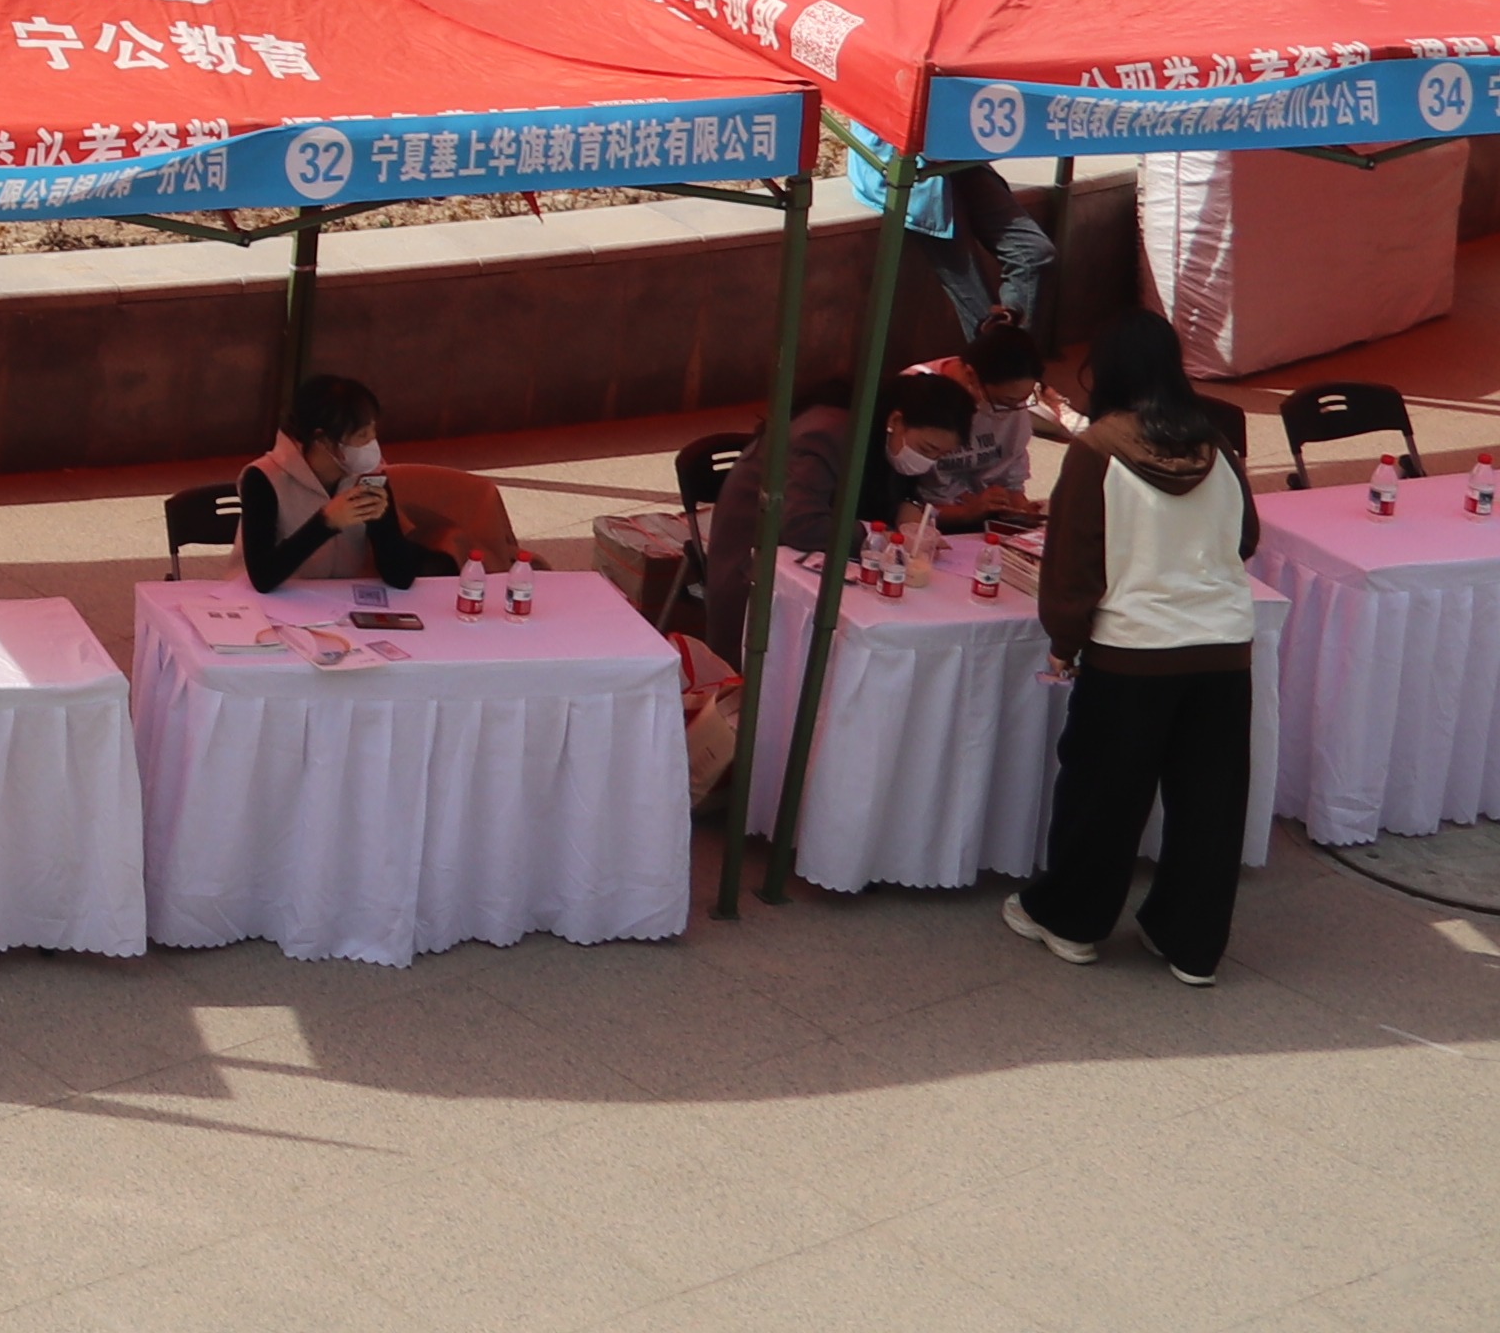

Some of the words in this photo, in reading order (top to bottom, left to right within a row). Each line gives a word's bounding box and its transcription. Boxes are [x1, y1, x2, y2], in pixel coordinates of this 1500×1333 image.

[11, 15, 321, 82] 宁公教育
[977, 96, 1018, 138] 33
[1427, 76, 1466, 118] 34
[298, 141, 345, 184] 32
[371, 114, 778, 184] 宁夏塞上华旗教育科技有限公司
